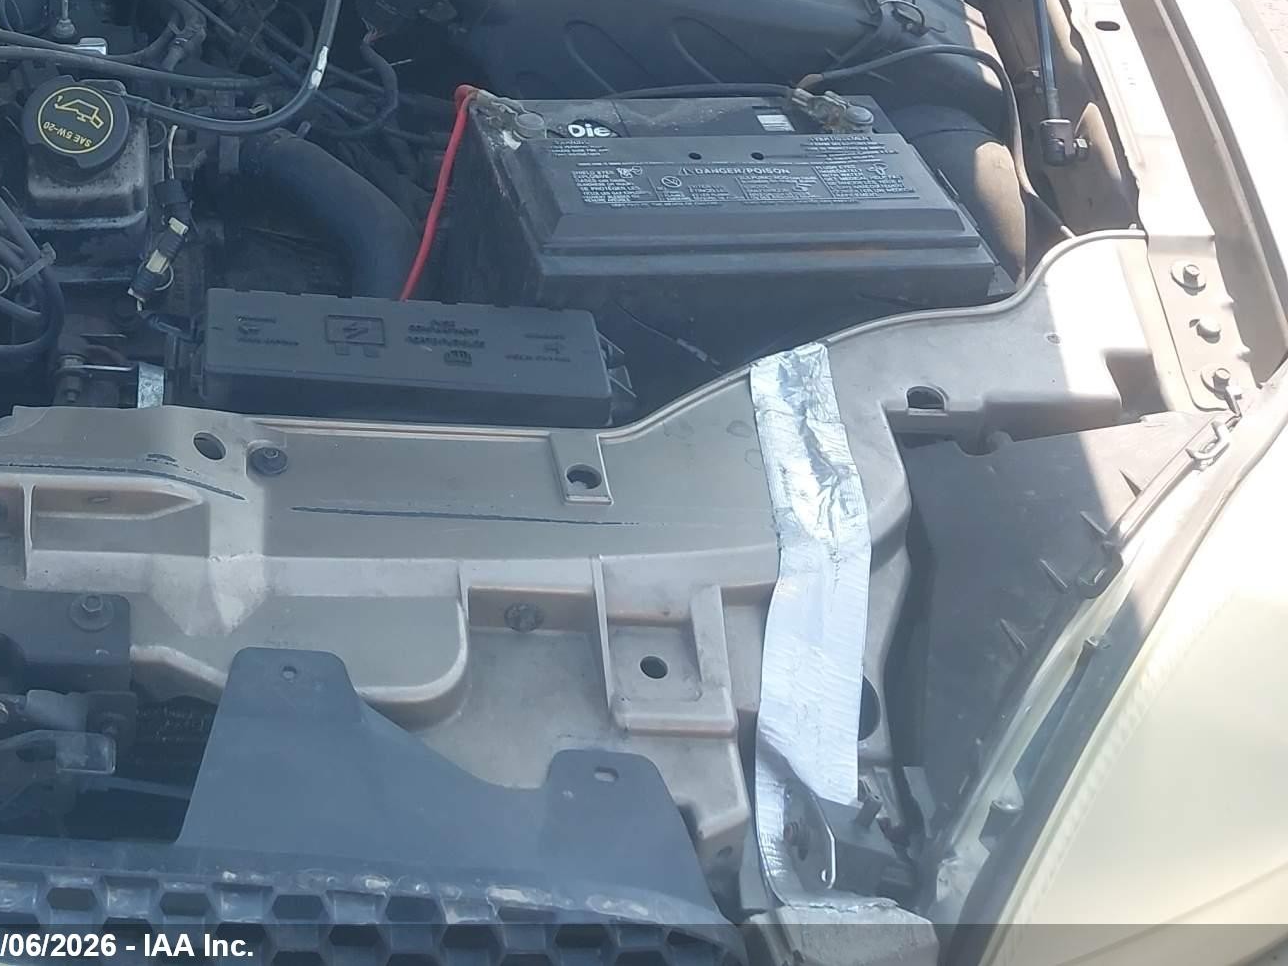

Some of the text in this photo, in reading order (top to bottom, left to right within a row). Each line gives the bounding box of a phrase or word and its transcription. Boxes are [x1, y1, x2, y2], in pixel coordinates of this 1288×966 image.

[43, 121, 93, 147] SAE 5W-20
[694, 167, 792, 175] DANGER/POISON
